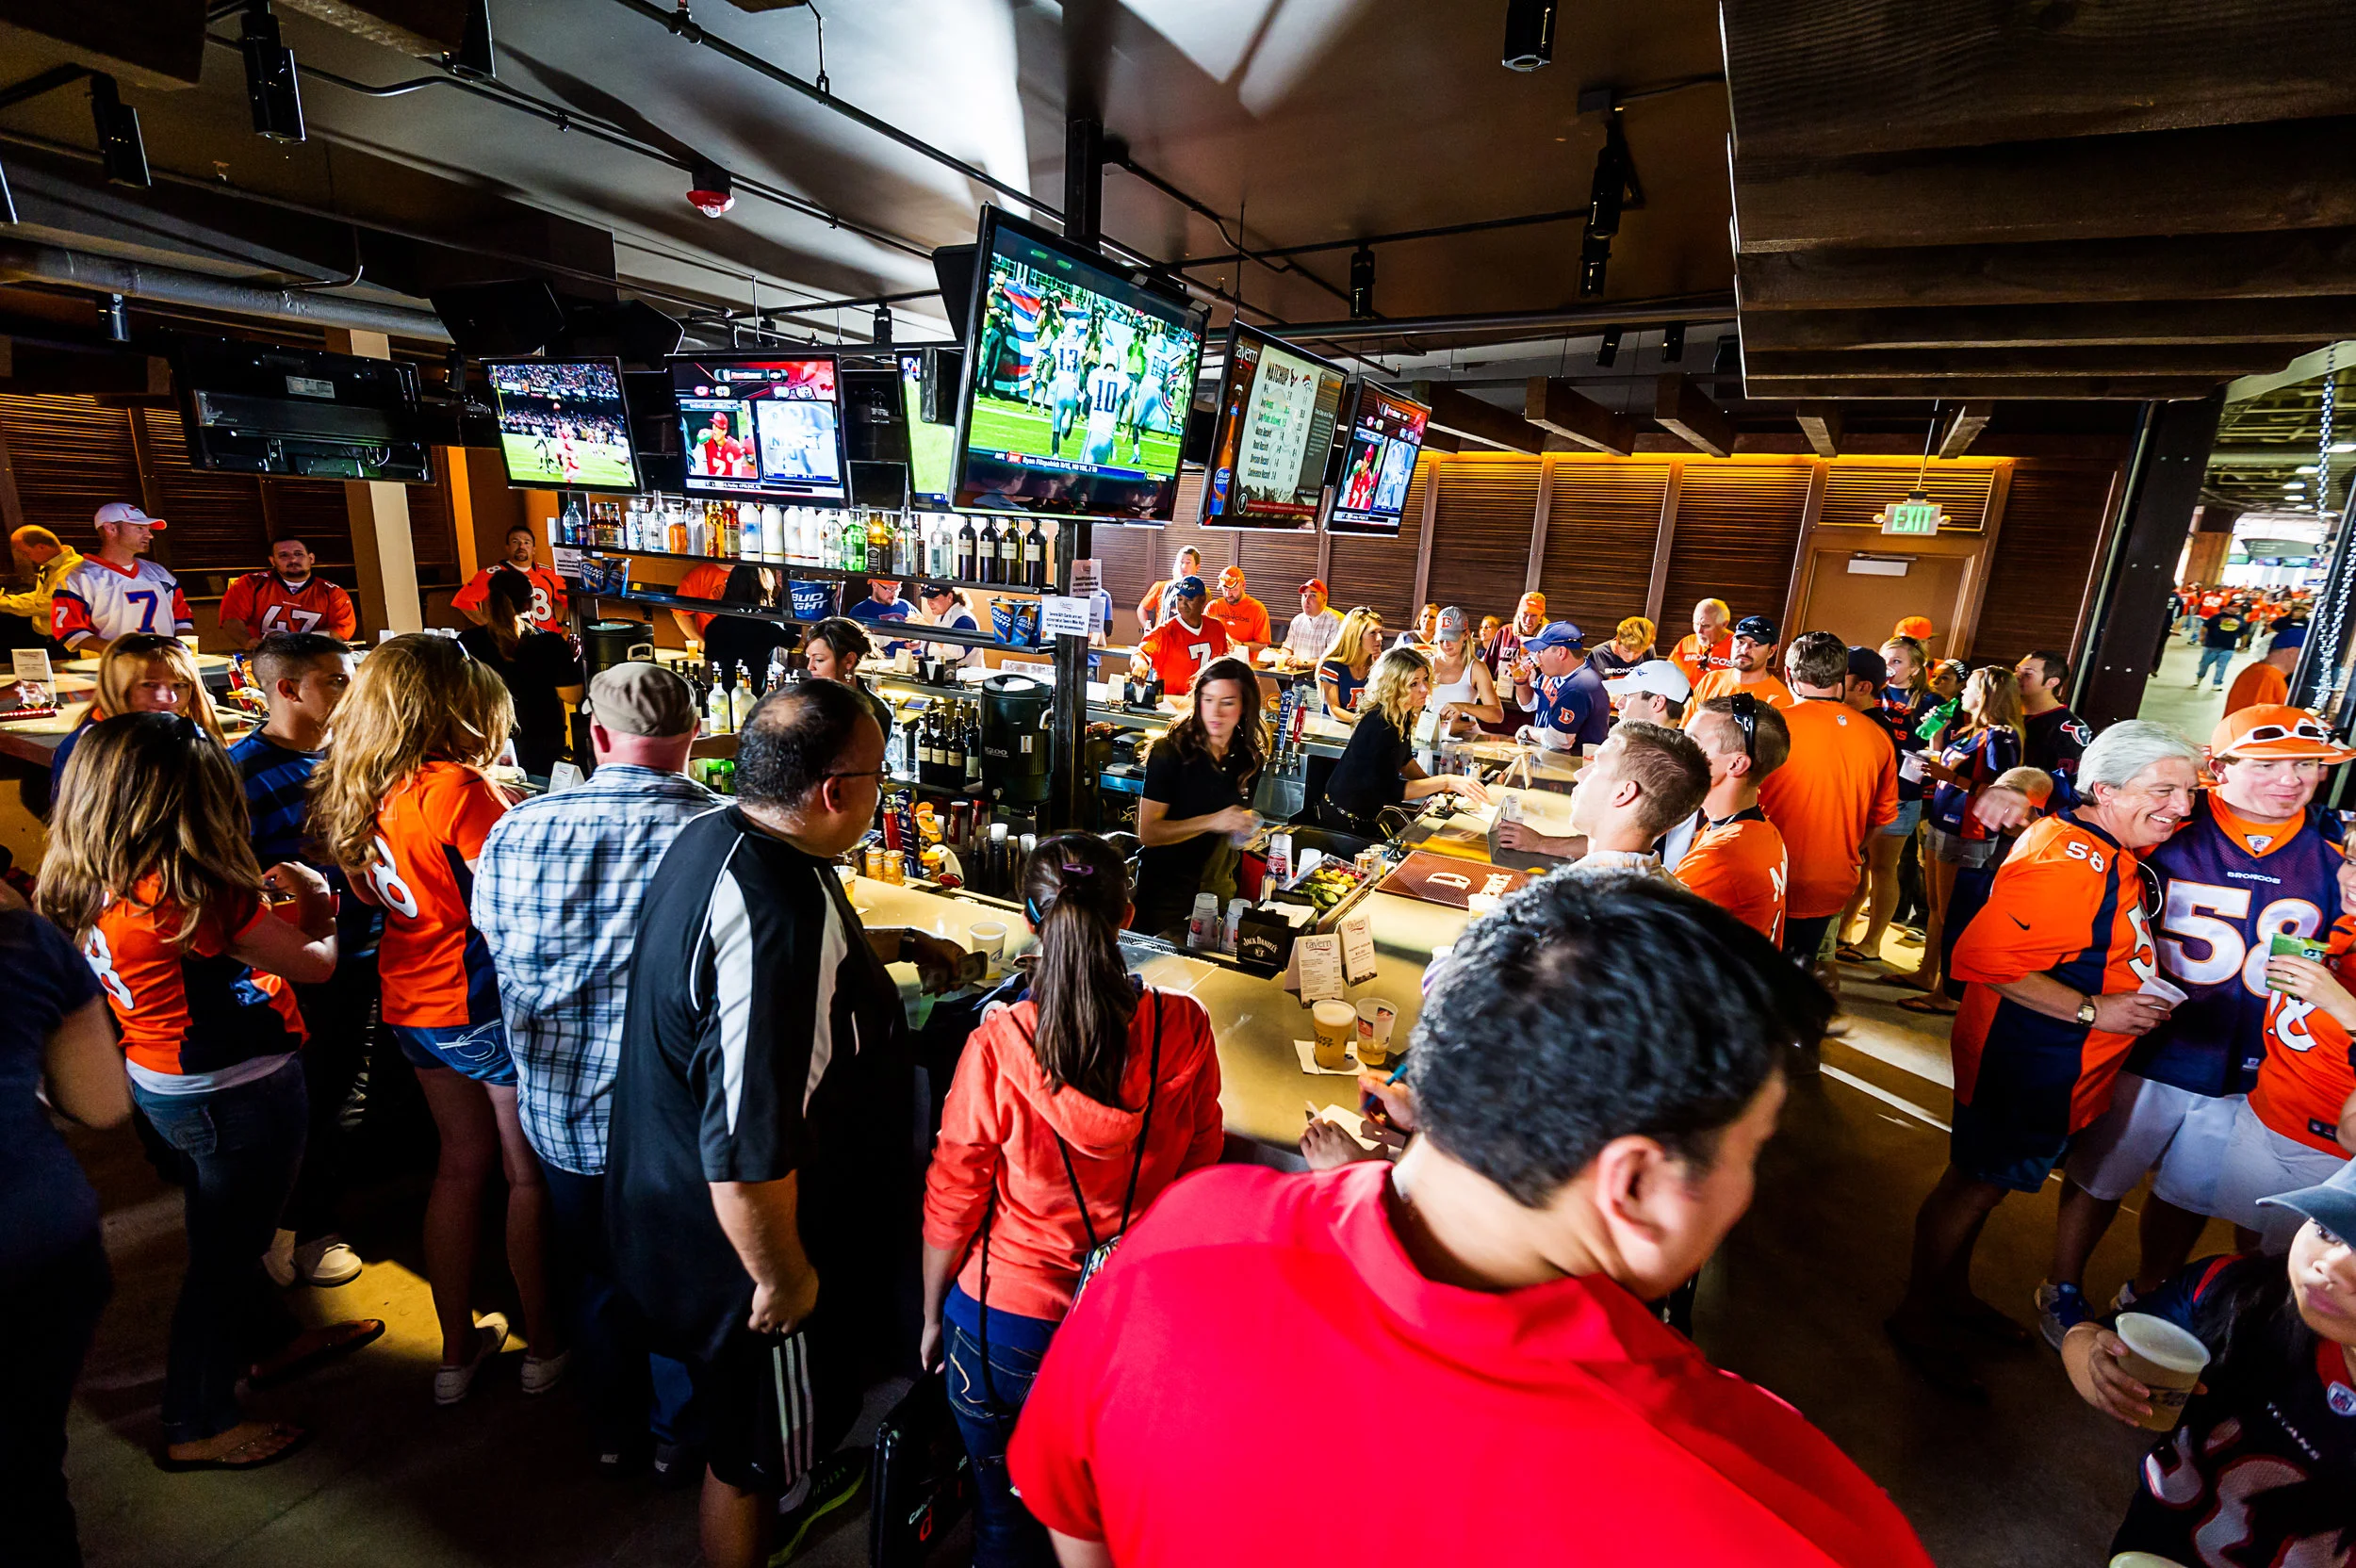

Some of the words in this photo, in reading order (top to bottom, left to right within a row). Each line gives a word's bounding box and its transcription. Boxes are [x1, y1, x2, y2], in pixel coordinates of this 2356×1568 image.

[1059, 348, 1078, 372] 13
[1094, 380, 1118, 413] 10
[1892, 505, 1935, 532] EXIT
[793, 593, 824, 603] BUD
[794, 600, 828, 612] IGHT
[56, 607, 69, 629] 7
[124, 590, 158, 634] 7
[261, 605, 322, 634] 47
[992, 609, 1011, 622] BUD
[1188, 643, 1212, 670] 7
[1501, 647, 1519, 659] TEXA
[985, 747, 1007, 756] IGLOO
[2066, 841, 2105, 874] 58
[2227, 872, 2281, 884] BRONCOS
[1243, 937, 1257, 947] JACK
[1257, 936, 1279, 954] DANIEL'S
[1305, 939, 1333, 950] tavern
[2126, 899, 2158, 984] 5
[2161, 879, 2323, 999] 58
